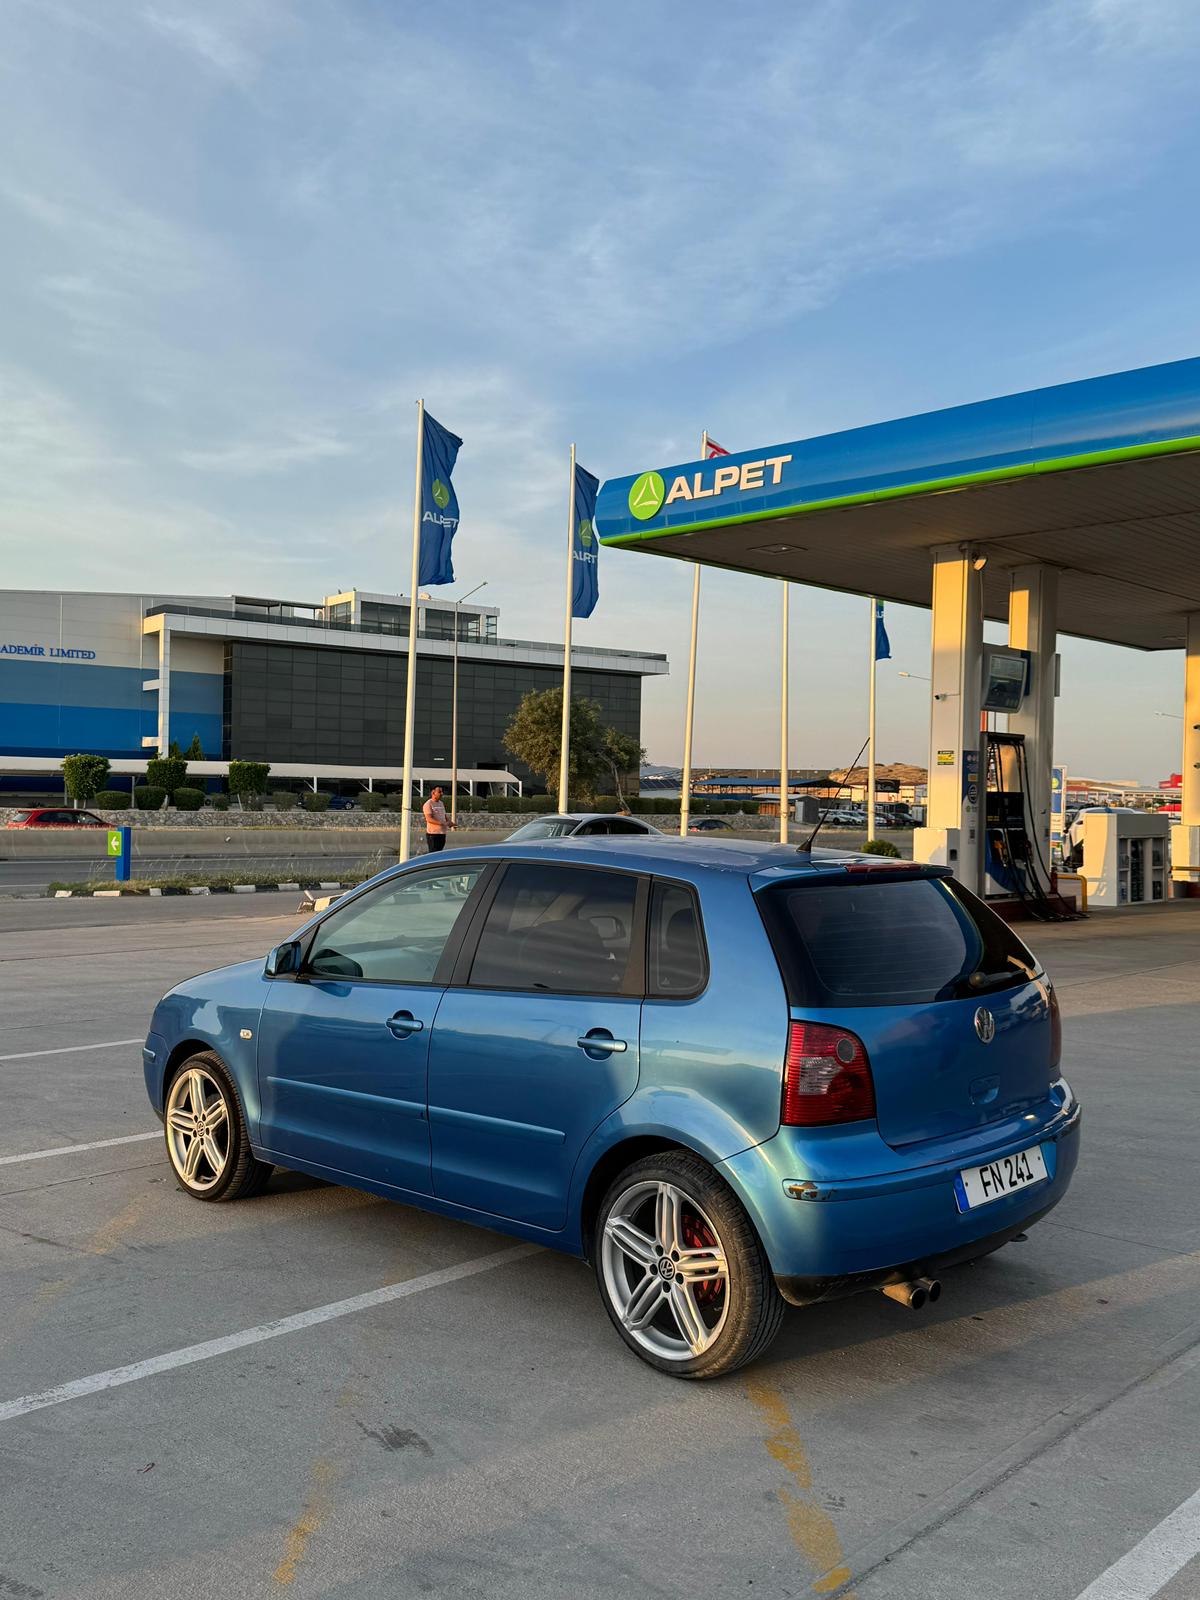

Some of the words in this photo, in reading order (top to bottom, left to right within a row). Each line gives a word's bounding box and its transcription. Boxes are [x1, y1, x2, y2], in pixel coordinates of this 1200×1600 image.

[665, 454, 793, 505] ALPET
[49, 647, 96, 660] LIMITED
[979, 1162, 1005, 1198] FN
[1004, 1152, 1034, 1188] 241
